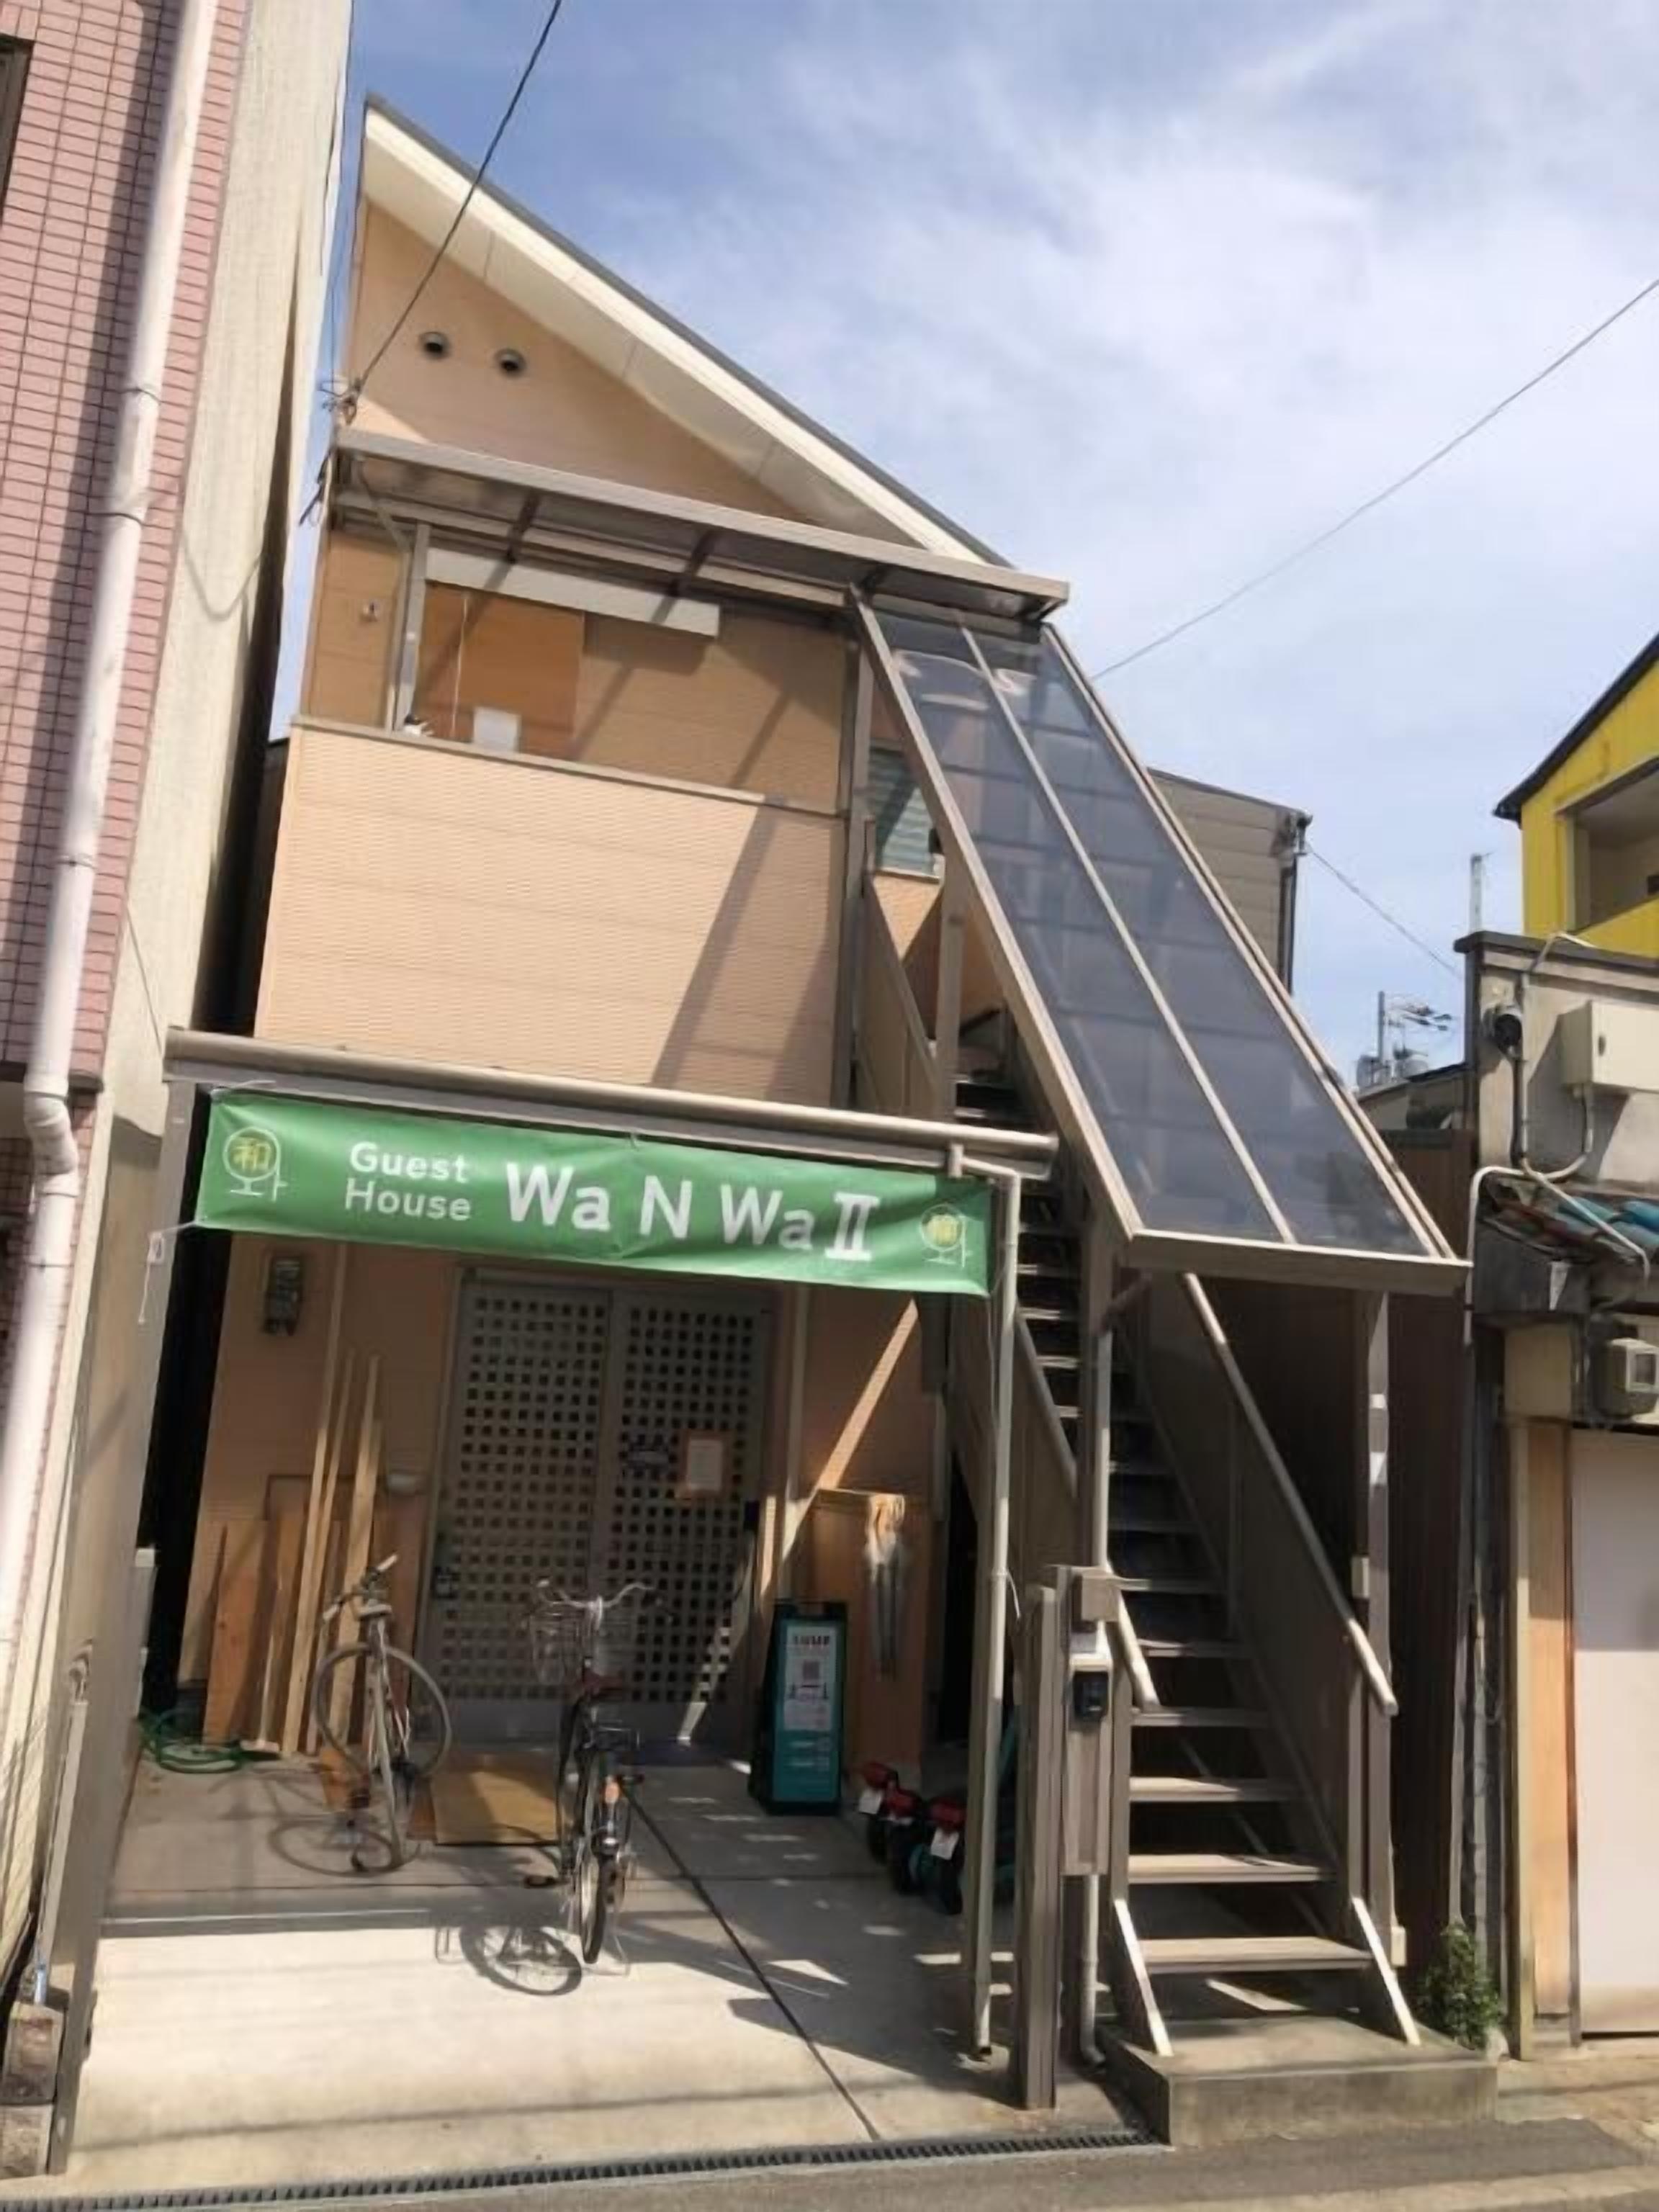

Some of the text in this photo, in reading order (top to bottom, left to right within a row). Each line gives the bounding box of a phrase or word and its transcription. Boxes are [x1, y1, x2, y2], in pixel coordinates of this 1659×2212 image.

[350, 1142, 470, 1183] Guest
[344, 1178, 472, 1223] House
[505, 1162, 611, 1231] Wa
[639, 1175, 693, 1238] N
[720, 1184, 815, 1250] Wa
